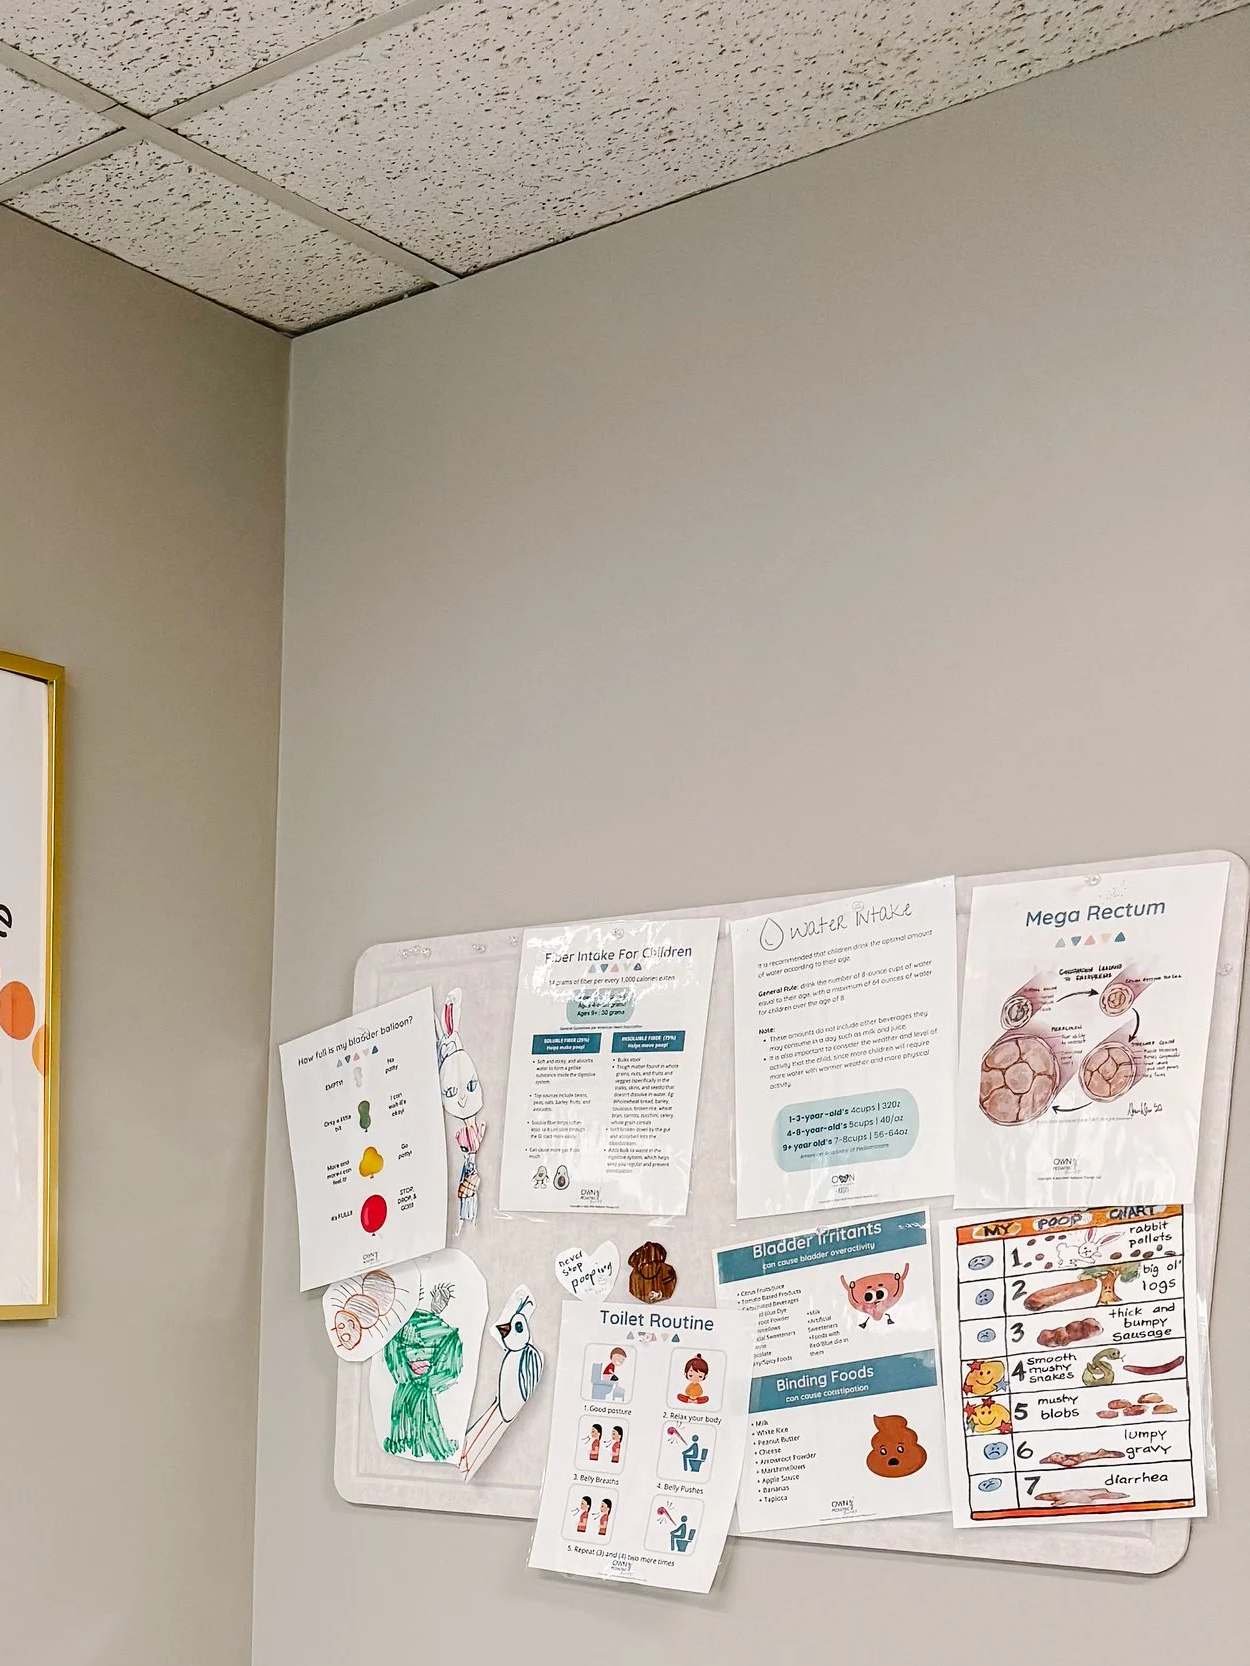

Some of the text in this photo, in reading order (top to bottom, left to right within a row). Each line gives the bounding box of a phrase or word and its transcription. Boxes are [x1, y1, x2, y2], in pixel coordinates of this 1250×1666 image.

[1025, 901, 1166, 928] Mega Rectum
[578, 950, 615, 961] Intake
[619, 949, 638, 960] For
[642, 946, 692, 958] Children
[769, 953, 812, 967] recommended
[827, 945, 852, 956] children
[870, 939, 880, 947] the
[882, 934, 907, 945] optimal
[908, 930, 932, 941] amount
[766, 969, 783, 977] water
[783, 962, 813, 974] according
[758, 986, 782, 997] General
[783, 984, 799, 993] Rule:
[800, 981, 815, 989] drink
[828, 974, 852, 984] number
[888, 966, 903, 974] cups
[914, 960, 932, 969] water
[758, 1027, 775, 1035] Note:
[298, 1015, 413, 1066] How full is my bladder balloon?
[851, 1106, 875, 1115] 4cups
[787, 1115, 904, 1137] 4-8-year-old's 5cups 40/oz
[794, 1140, 811, 1152] year
[813, 1138, 832, 1148] old's
[834, 1133, 868, 1144] 7-8cups
[874, 1129, 908, 1139] 56-64oz
[983, 1205, 1158, 1237] MY POOP CHART
[1129, 1222, 1169, 1234] rabbit
[753, 1222, 882, 1258] Bladder Irritants
[1129, 1233, 1172, 1248] pellets
[559, 1250, 582, 1267] never
[762, 1242, 876, 1270] can cause bladder overactivity
[563, 1263, 582, 1276] stop
[1143, 1260, 1182, 1277] big ol'
[572, 1262, 612, 1293] pooping
[1012, 1281, 1027, 1300] 2
[1142, 1279, 1176, 1293] logs
[1108, 1303, 1175, 1318] thick and
[600, 1311, 714, 1331] Toilet Routine
[1124, 1318, 1167, 1329] bumpy
[1011, 1323, 1024, 1342] 3
[1027, 1354, 1077, 1365] smooth
[1012, 1360, 1026, 1381] 4
[1029, 1363, 1071, 1374] mushy
[776, 1366, 874, 1392] Binding Foods
[1030, 1372, 1074, 1383] snakes
[824, 1384, 869, 1397] constipation
[1037, 1394, 1079, 1405] mushy
[590, 1405, 606, 1413] Good
[608, 1407, 632, 1416] posture
[1014, 1403, 1028, 1420] 5
[1041, 1407, 1080, 1420] blobs
[670, 1413, 687, 1421] Relax
[705, 1416, 722, 1425] body
[1125, 1429, 1167, 1441] lumpy
[793, 1453, 816, 1461] Powder
[1017, 1441, 1033, 1459] 6
[1126, 1445, 1172, 1459] gravy
[580, 1475, 594, 1484] Belly
[596, 1476, 619, 1486] Breaths
[1024, 1476, 1041, 1495] 7
[1105, 1472, 1168, 1486] diarrhea
[664, 1484, 679, 1493] Belly
[681, 1486, 703, 1495] Pushes
[574, 1546, 595, 1557] Repeat
[596, 1549, 604, 1558] (3)
[658, 1559, 675, 1567] times
